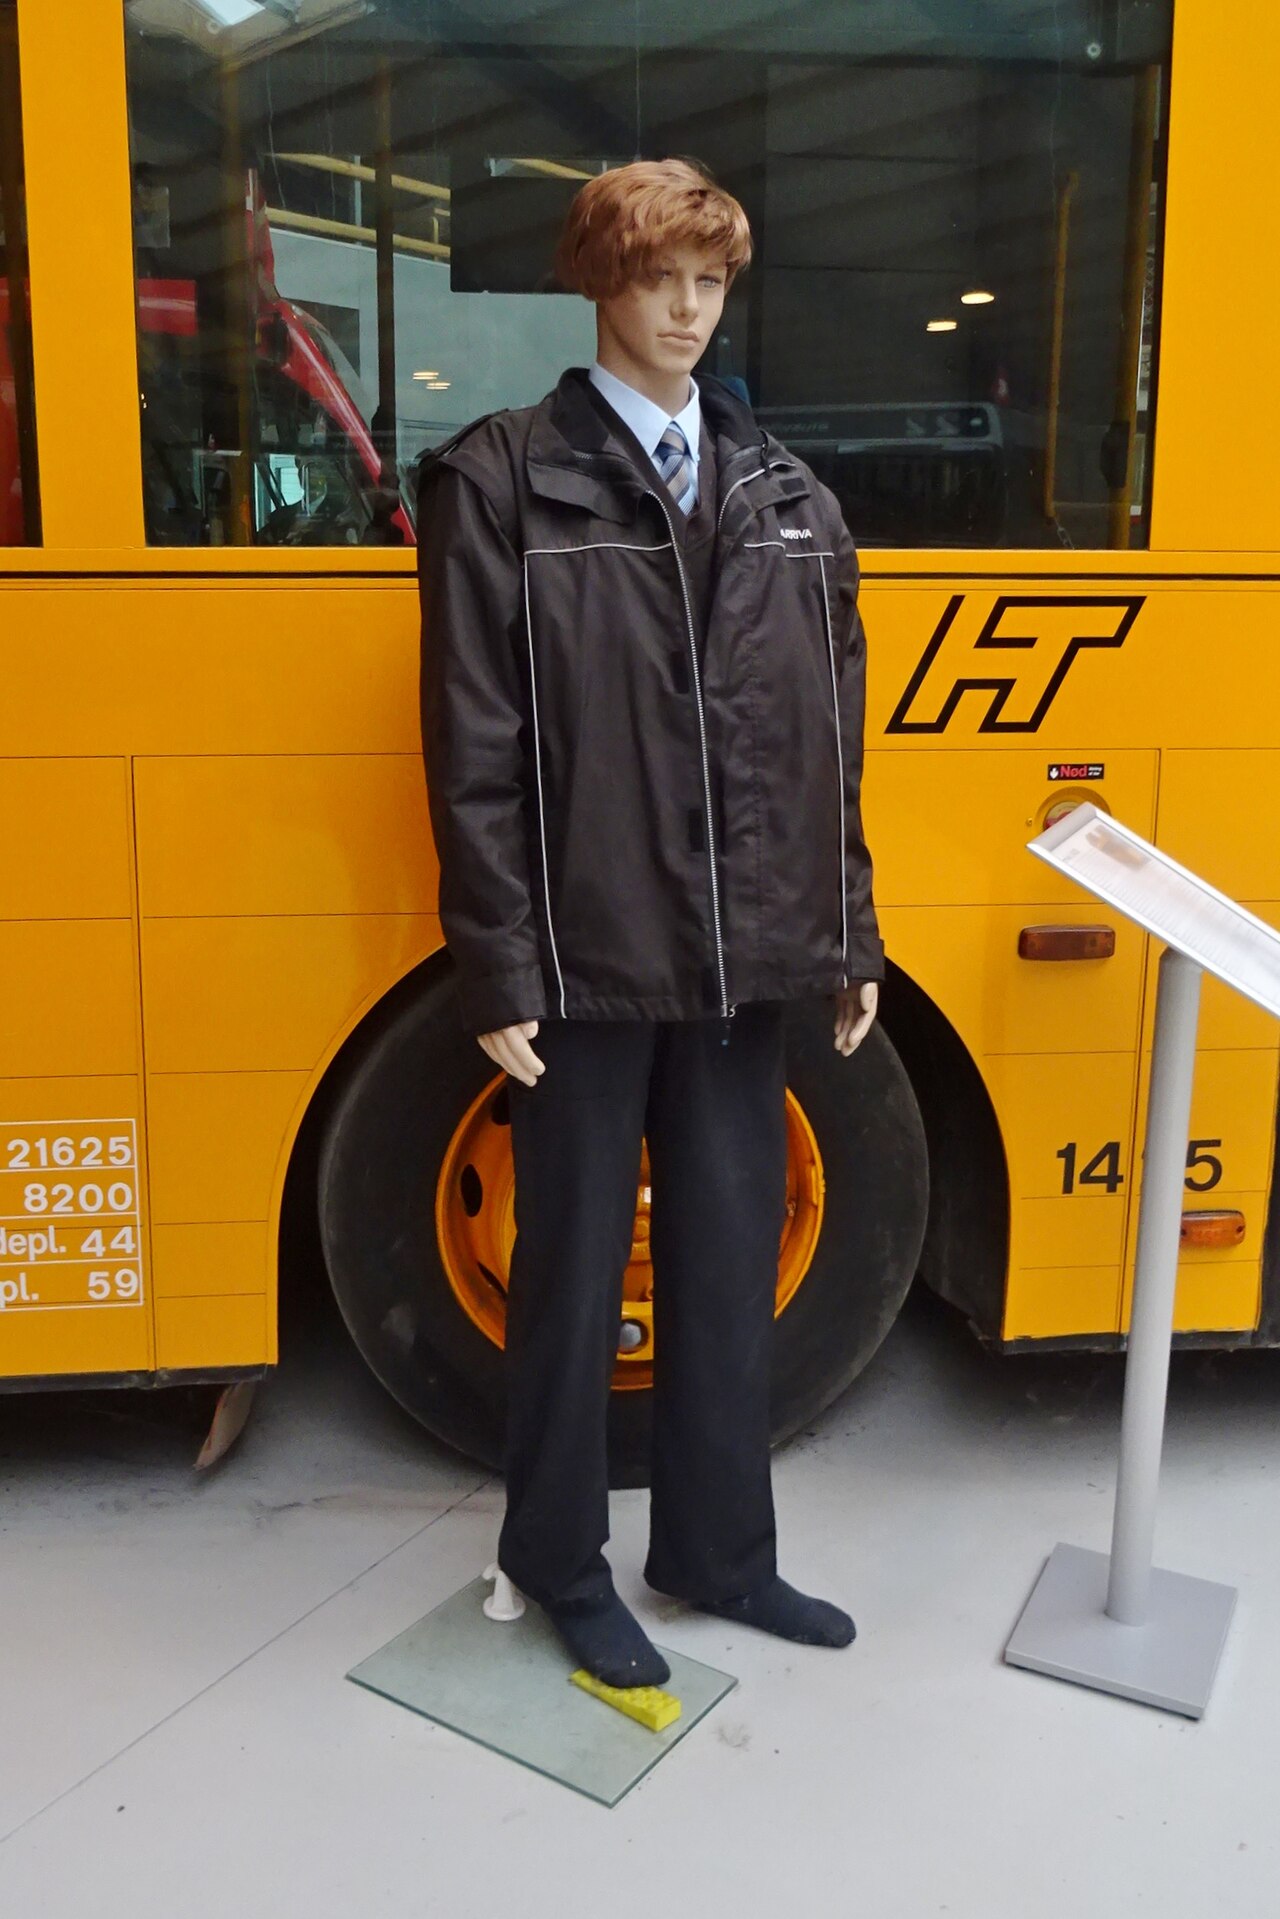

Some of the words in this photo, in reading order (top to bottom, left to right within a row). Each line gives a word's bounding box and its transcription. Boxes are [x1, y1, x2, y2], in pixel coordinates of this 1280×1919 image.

[884, 594, 1148, 734] HT
[1060, 765, 1087, 777] Nød
[7, 1136, 132, 1168] 21625
[1056, 1138, 1223, 1195] 145
[23, 1182, 132, 1213] 8200
[80, 1226, 136, 1257] 44
[88, 1268, 138, 1300] 59
